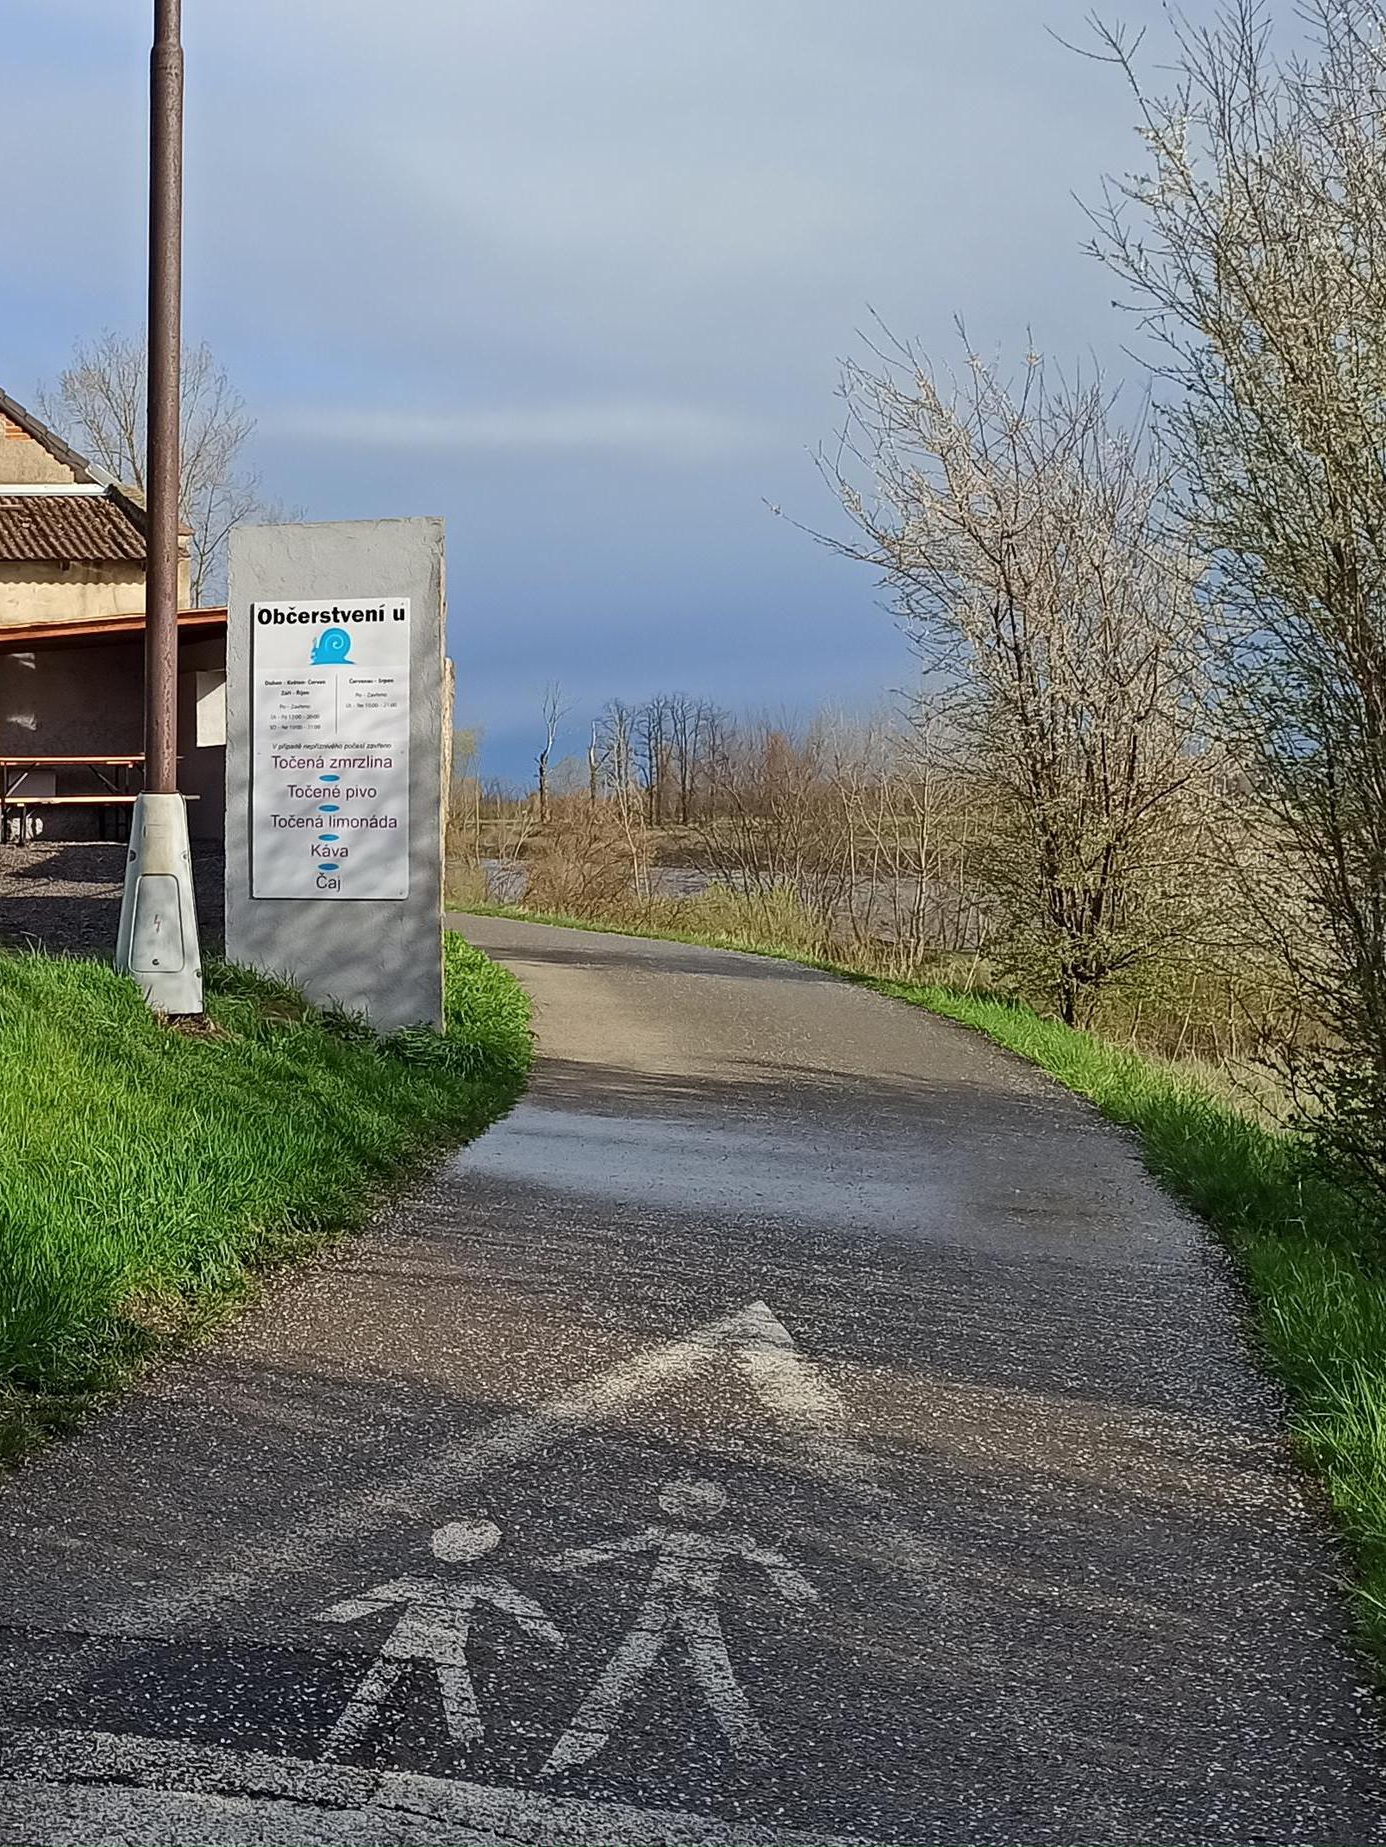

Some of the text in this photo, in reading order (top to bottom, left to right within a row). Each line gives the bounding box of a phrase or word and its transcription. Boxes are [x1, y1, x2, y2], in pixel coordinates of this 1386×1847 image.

[257, 604, 406, 625] Občerstvení u
[271, 755, 393, 769] Točená zmrzlina
[287, 785, 377, 800] Točené pivo
[270, 814, 398, 829] Točená limonáda
[310, 844, 349, 858] Káva
[316, 872, 341, 891] Čaj
